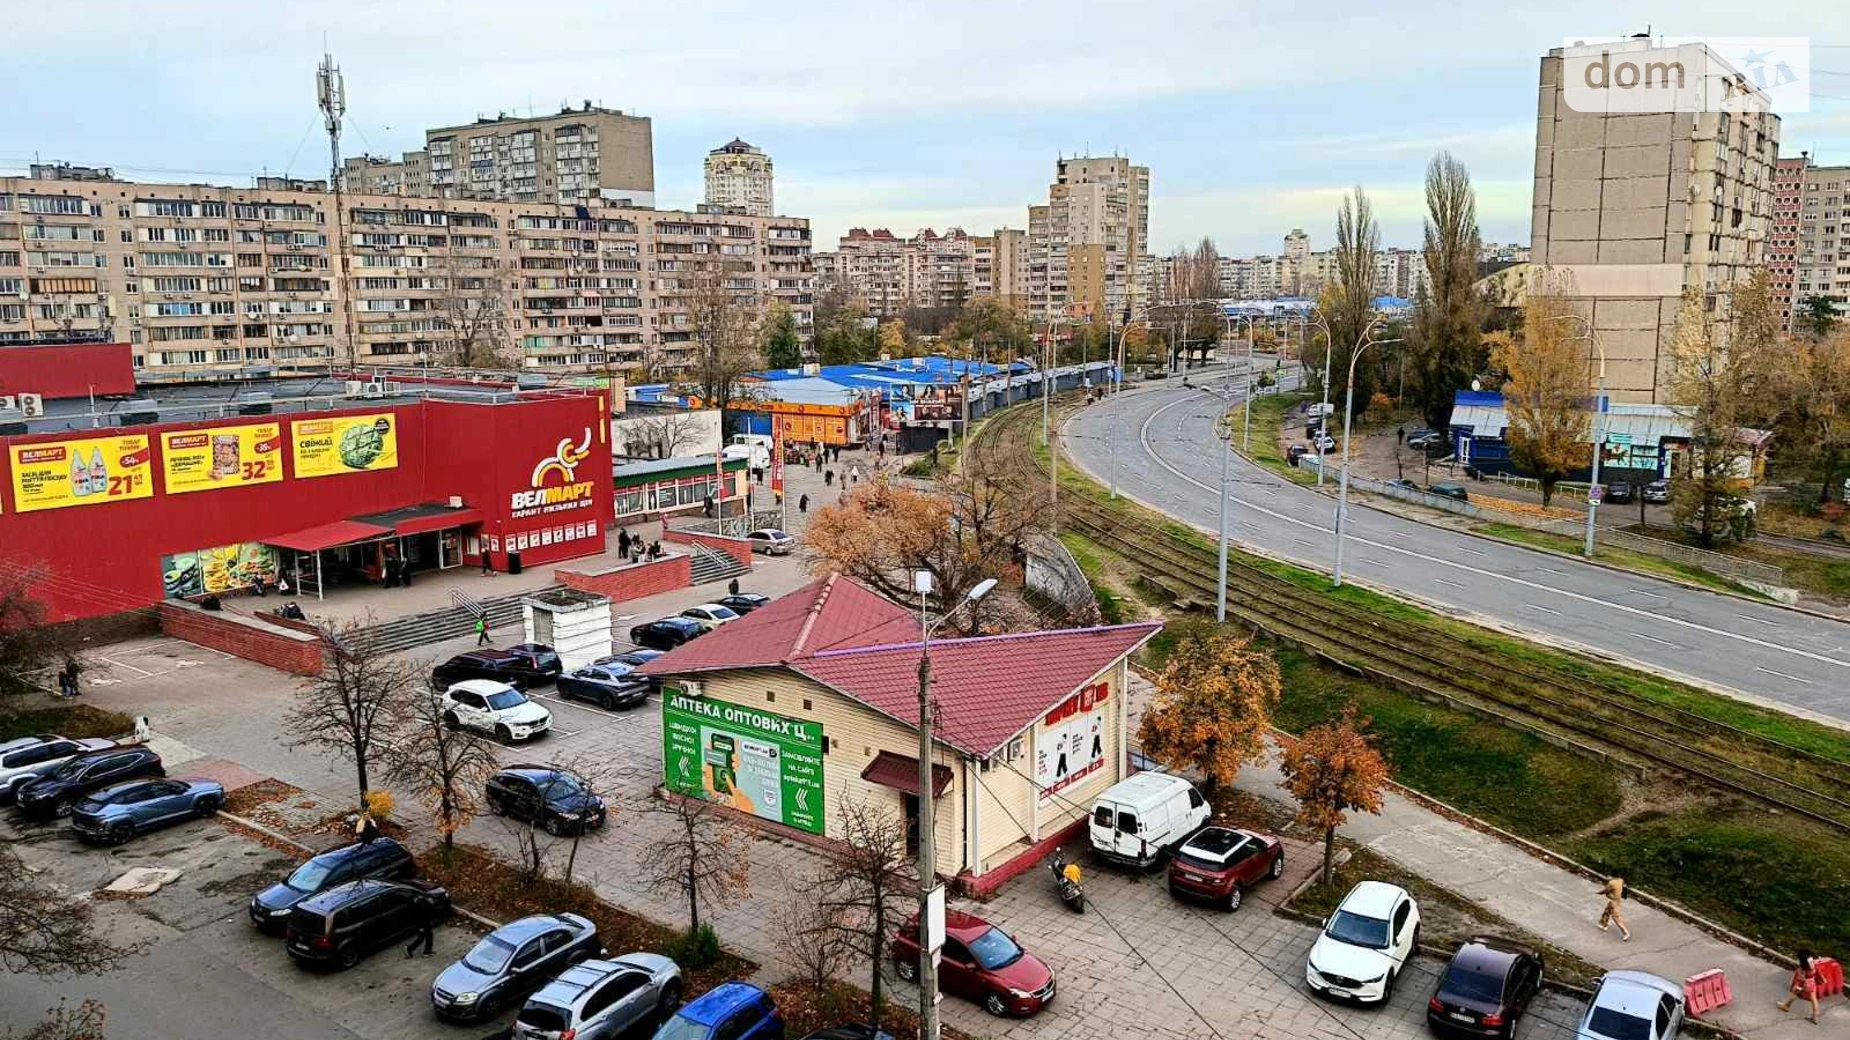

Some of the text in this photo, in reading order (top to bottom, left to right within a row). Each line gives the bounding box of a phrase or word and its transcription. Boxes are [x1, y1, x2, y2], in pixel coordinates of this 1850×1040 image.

[242, 460, 266, 480] 32
[108, 475, 132, 496] 21
[512, 481, 594, 508] ВЕЛМАРТ
[670, 695, 721, 719] АПТЕКА
[724, 708, 791, 735] ОПТОВИХ
